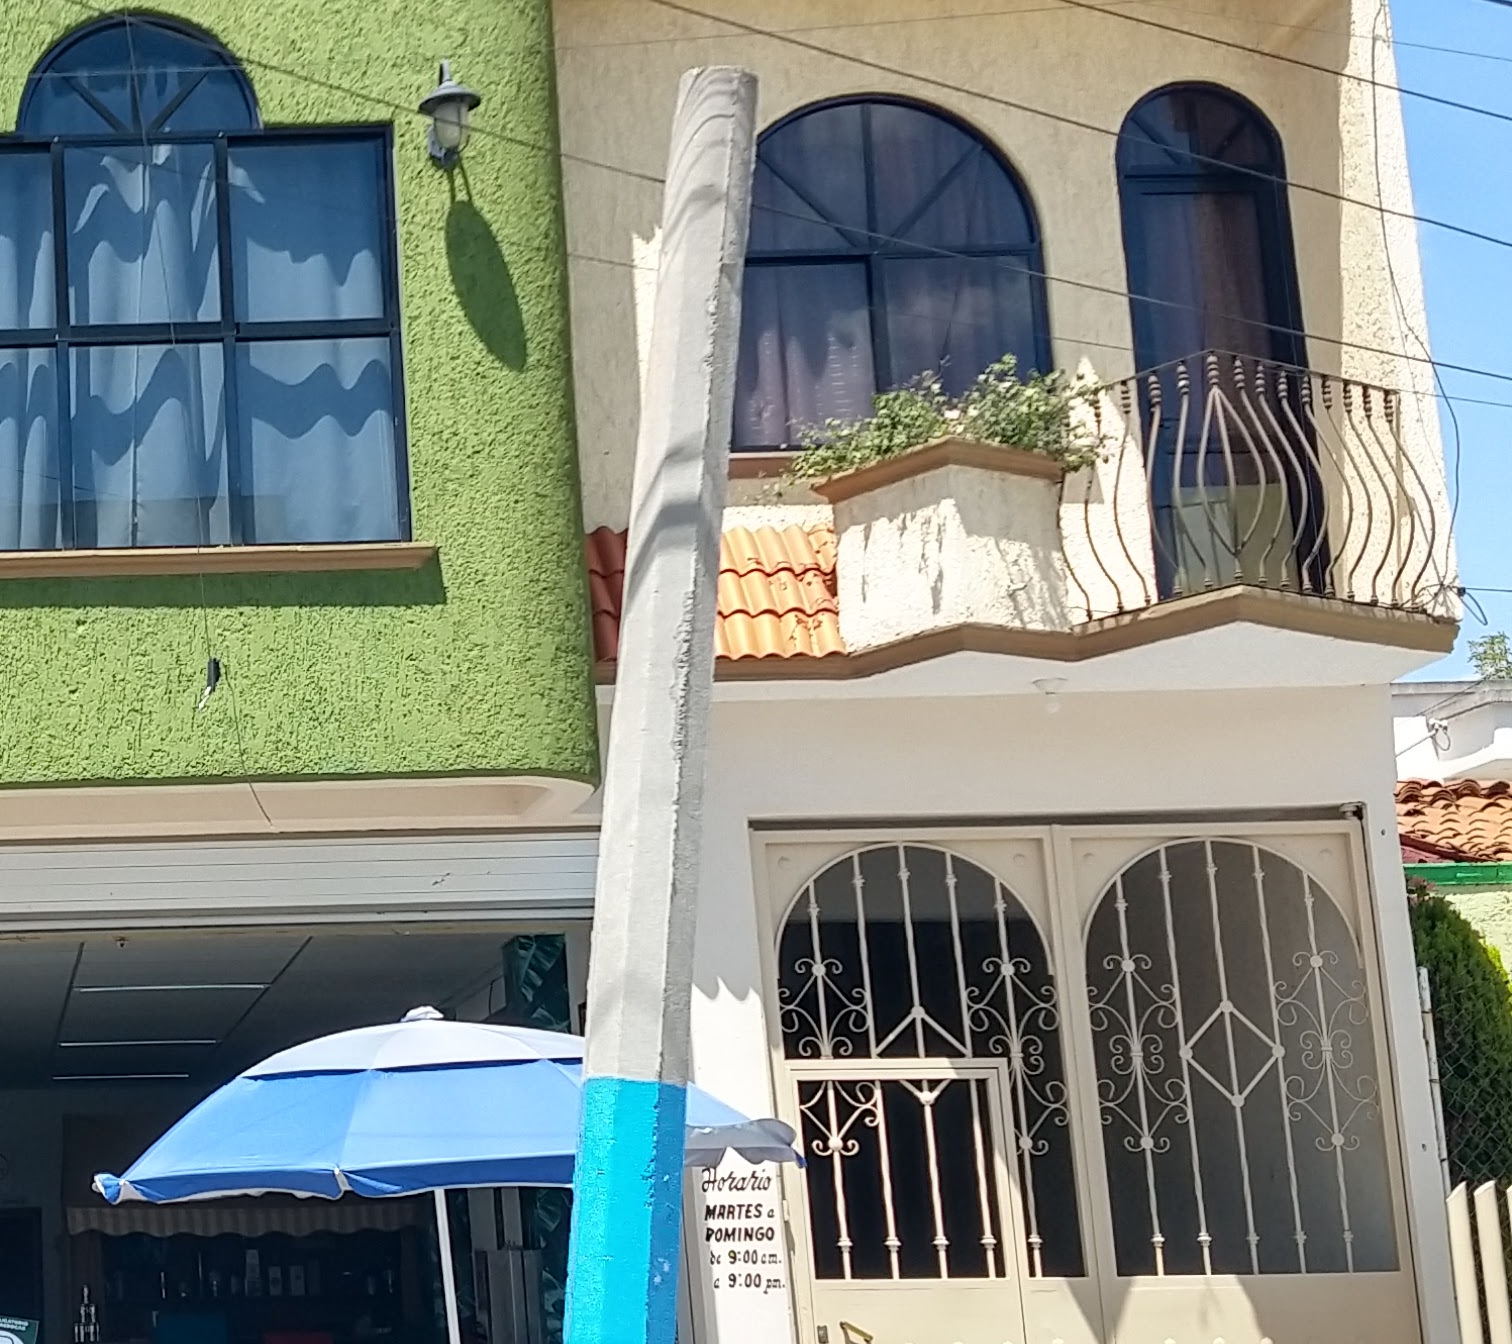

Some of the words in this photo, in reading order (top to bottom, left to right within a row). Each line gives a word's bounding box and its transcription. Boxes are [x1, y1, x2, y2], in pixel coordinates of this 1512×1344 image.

[701, 1167, 772, 1192] Horario
[704, 1203, 763, 1221] MARTES
[705, 1226, 775, 1242] DOMINGO
[728, 1249, 758, 1264] 9:00
[728, 1273, 761, 1288] 9:00
